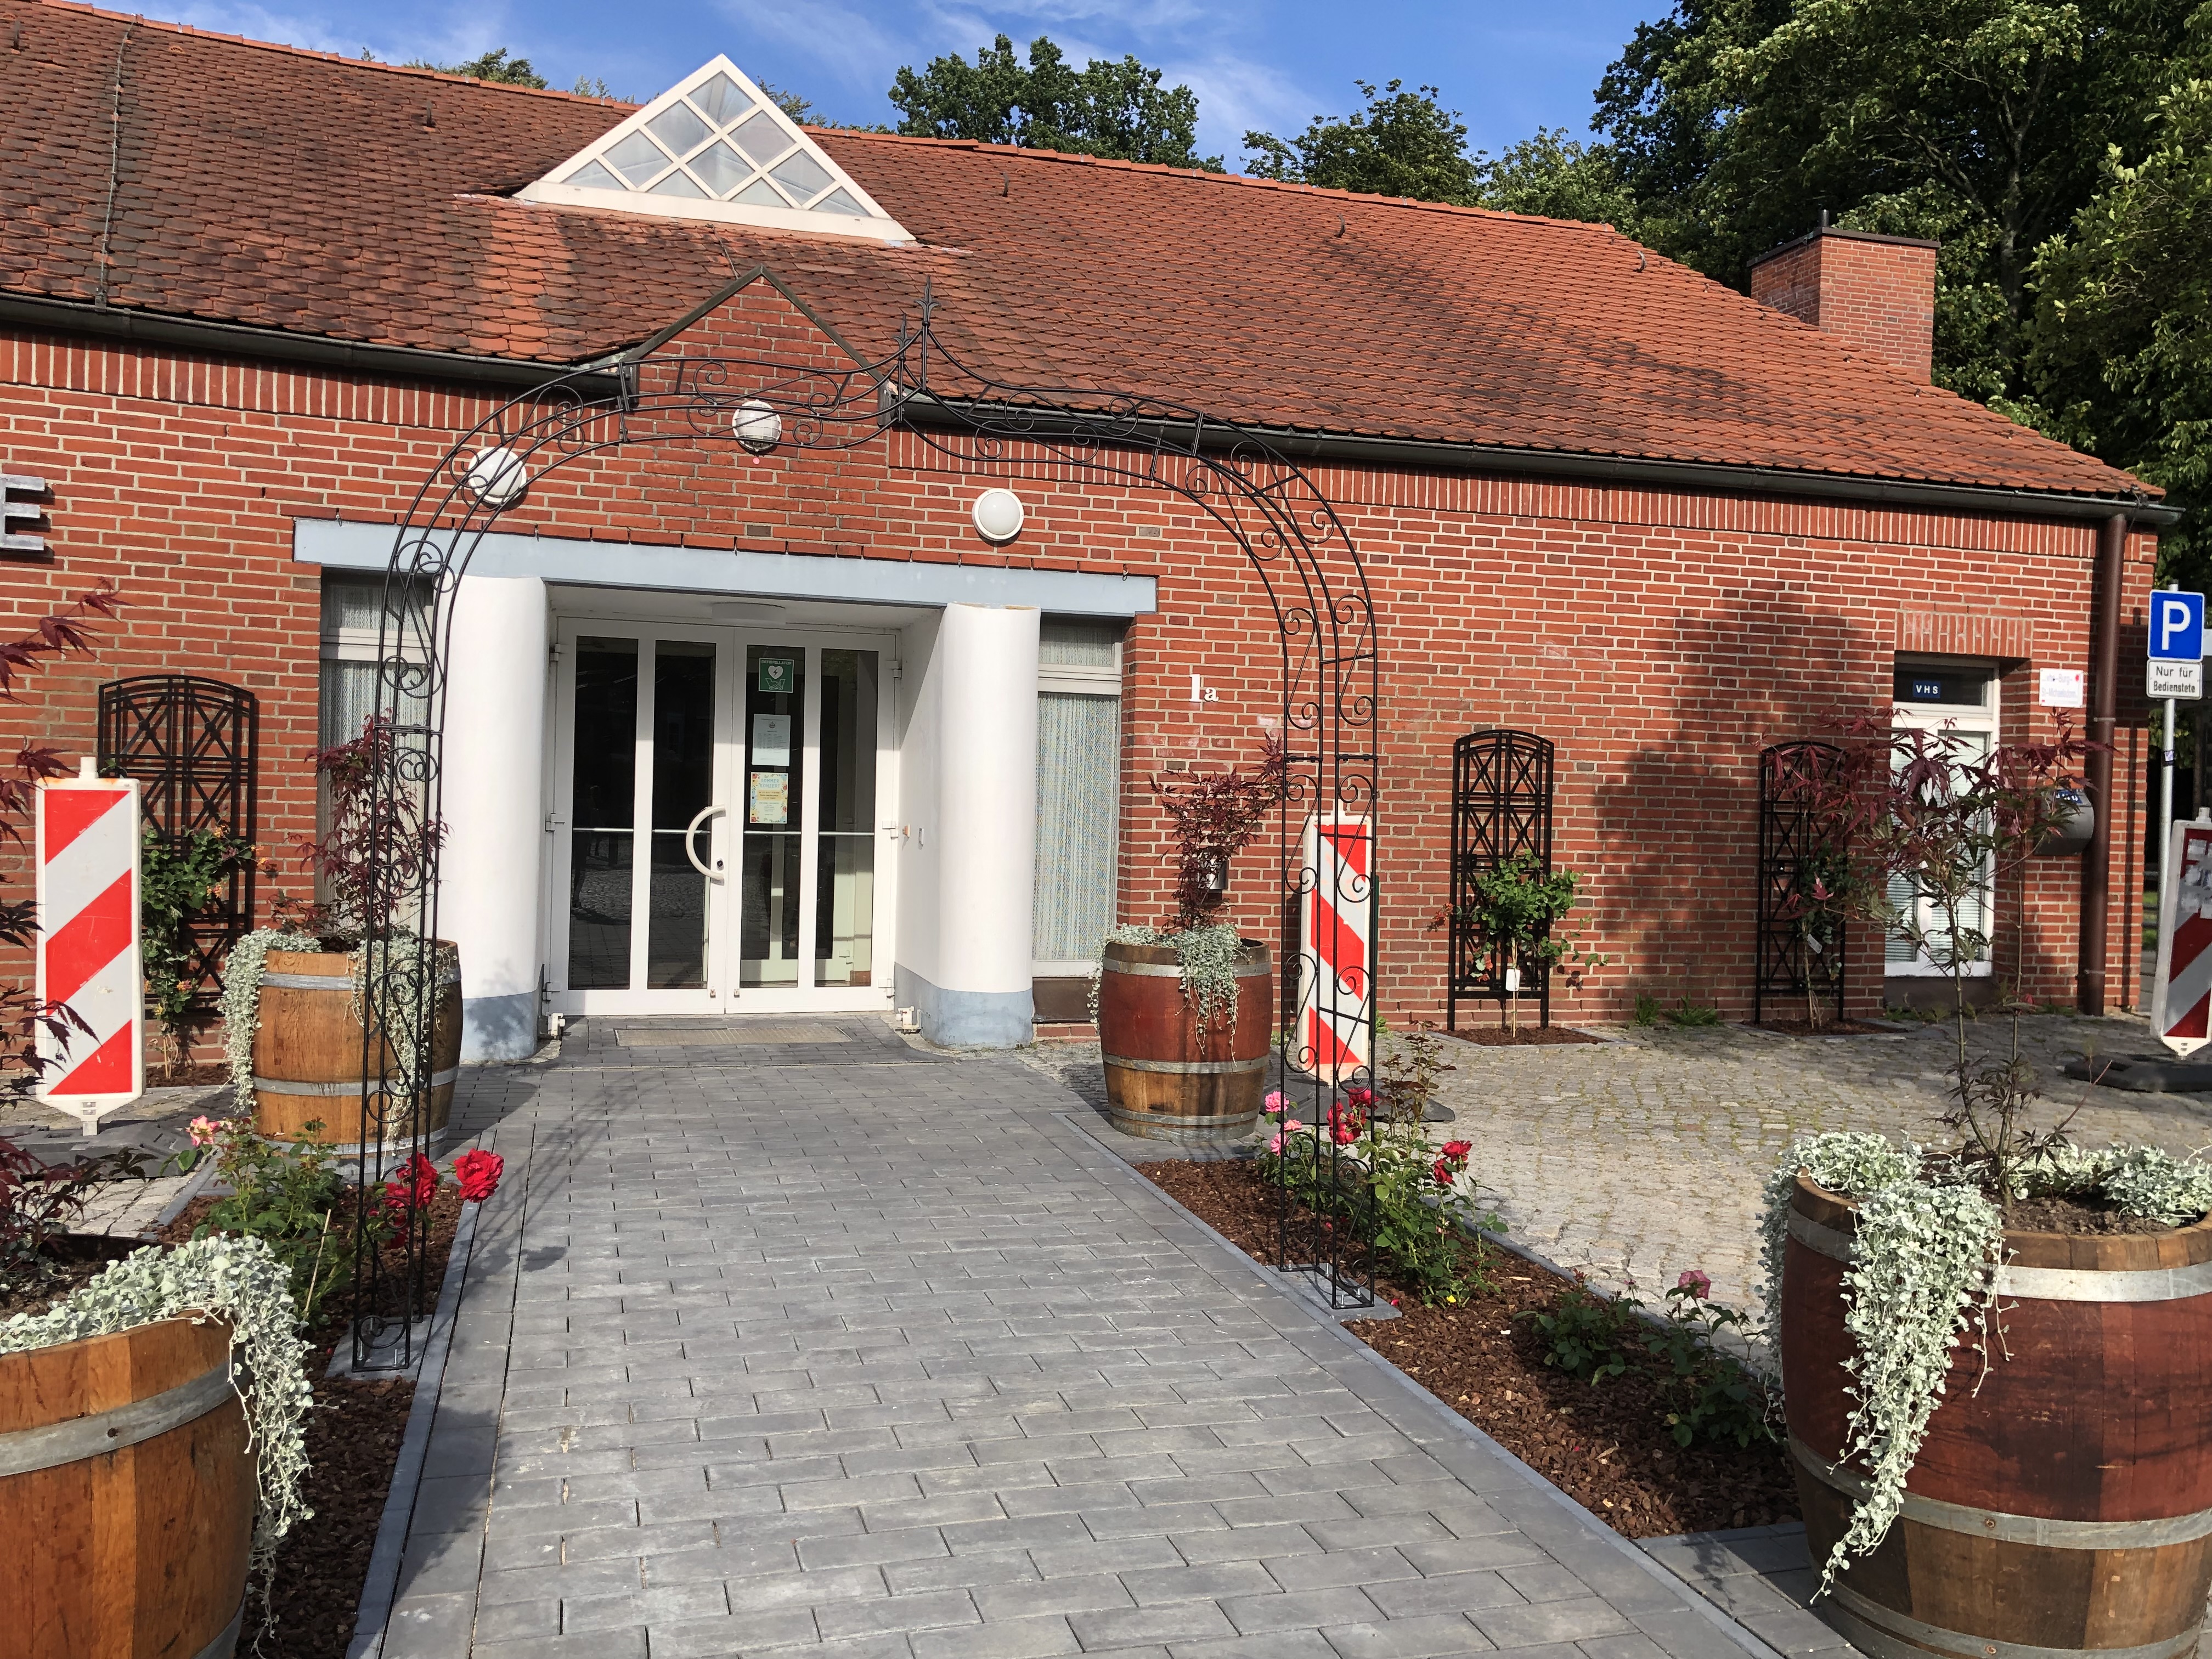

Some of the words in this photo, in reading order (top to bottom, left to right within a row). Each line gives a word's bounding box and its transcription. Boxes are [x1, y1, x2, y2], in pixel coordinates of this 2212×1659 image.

[2162, 600, 2191, 651] P
[2155, 665, 2174, 677] Nur
[2179, 667, 2193, 678] für
[1916, 684, 1938, 695] VHS
[2153, 680, 2196, 693] Bedienstete
